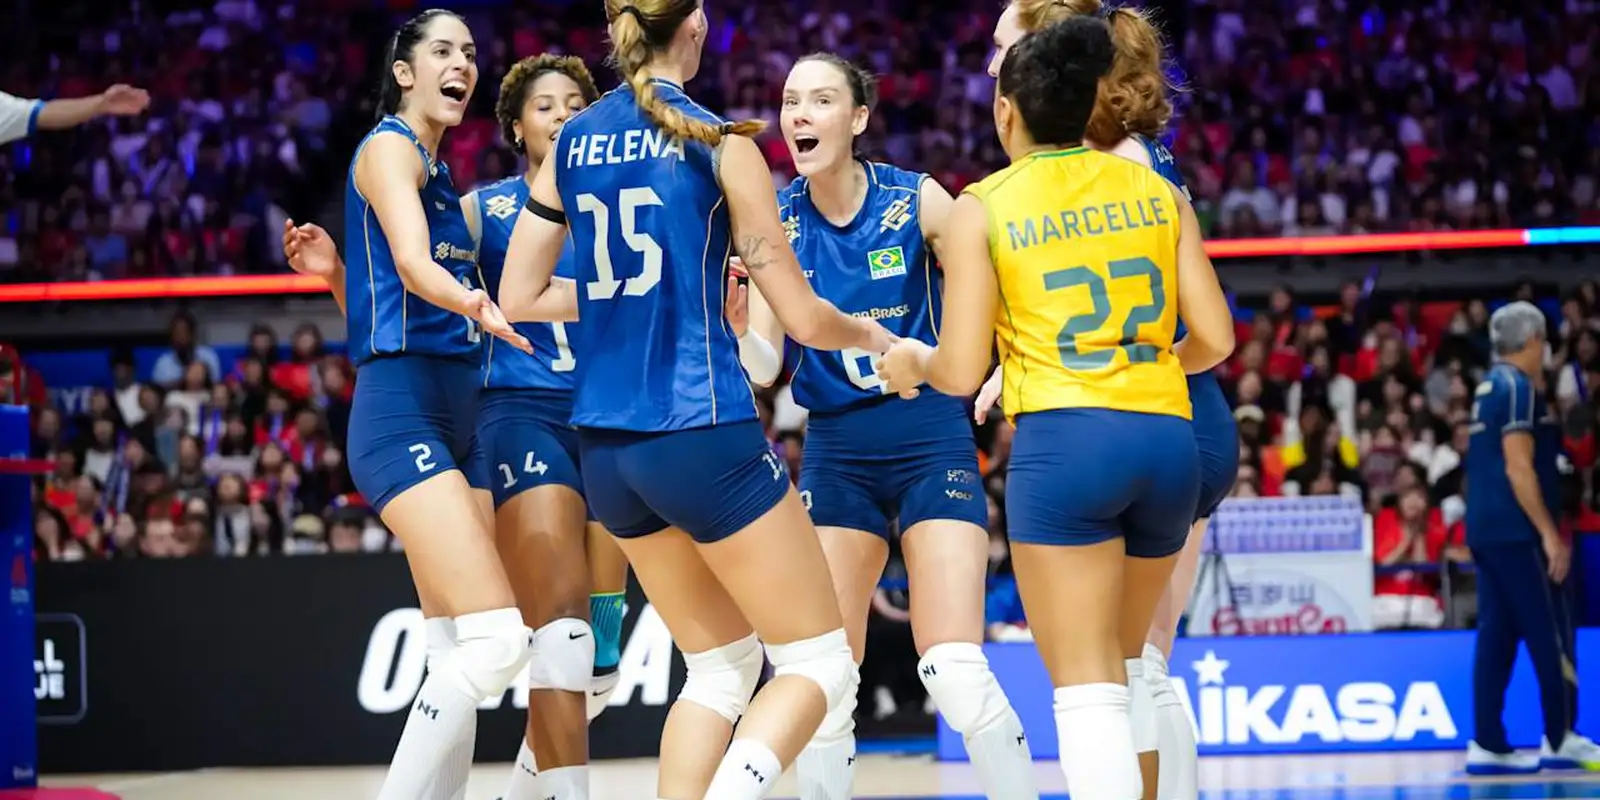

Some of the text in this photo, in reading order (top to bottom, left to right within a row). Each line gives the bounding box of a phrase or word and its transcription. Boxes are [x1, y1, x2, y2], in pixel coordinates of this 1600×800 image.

[567, 129, 686, 169] HELENA
[576, 186, 664, 300] 15
[1006, 197, 1168, 251] MARCELLE
[1043, 256, 1166, 370] 22
[408, 443, 437, 473] 2
[498, 451, 549, 489] 14
[416, 700, 440, 720] N1
